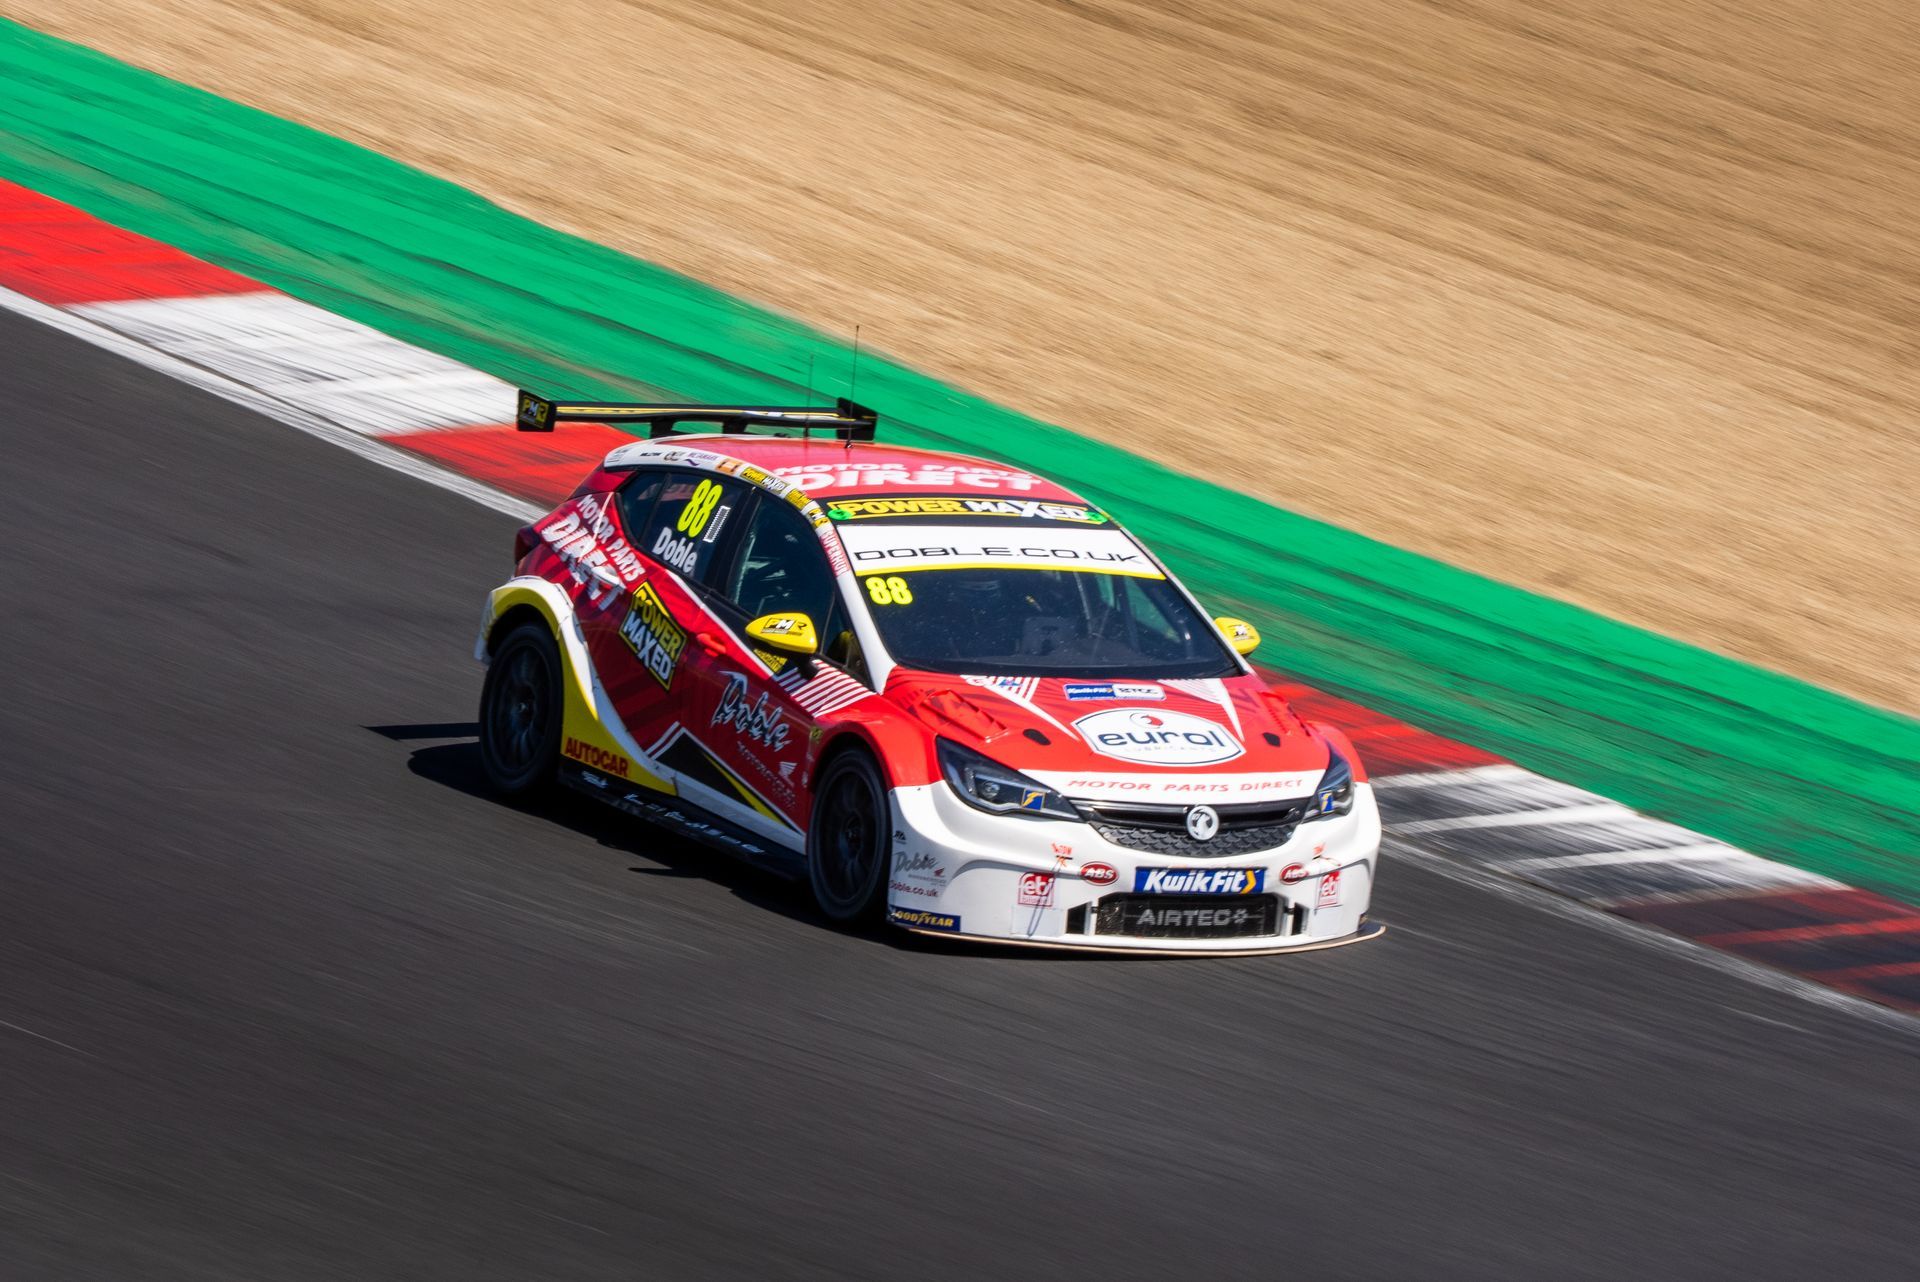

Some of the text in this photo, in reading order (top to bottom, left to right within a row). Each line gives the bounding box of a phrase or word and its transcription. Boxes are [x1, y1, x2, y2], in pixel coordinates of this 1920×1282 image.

[788, 470, 1042, 491] DIRECT
[677, 479, 723, 538] 88
[838, 500, 1090, 519] POWER MAXED
[576, 494, 646, 582] MOTOR PARTS
[652, 526, 698, 573] Doble
[854, 547, 1143, 564] DOBLE.CO.UK
[865, 576, 913, 605] 88
[634, 588, 682, 659] POWER
[622, 610, 673, 680] MAXED
[564, 737, 630, 777] AUTOCAR
[1068, 779, 1303, 792] MOTOR PARTS DIRECT
[1084, 867, 1115, 879] ABS
[1136, 909, 1232, 926] AIRTEC
